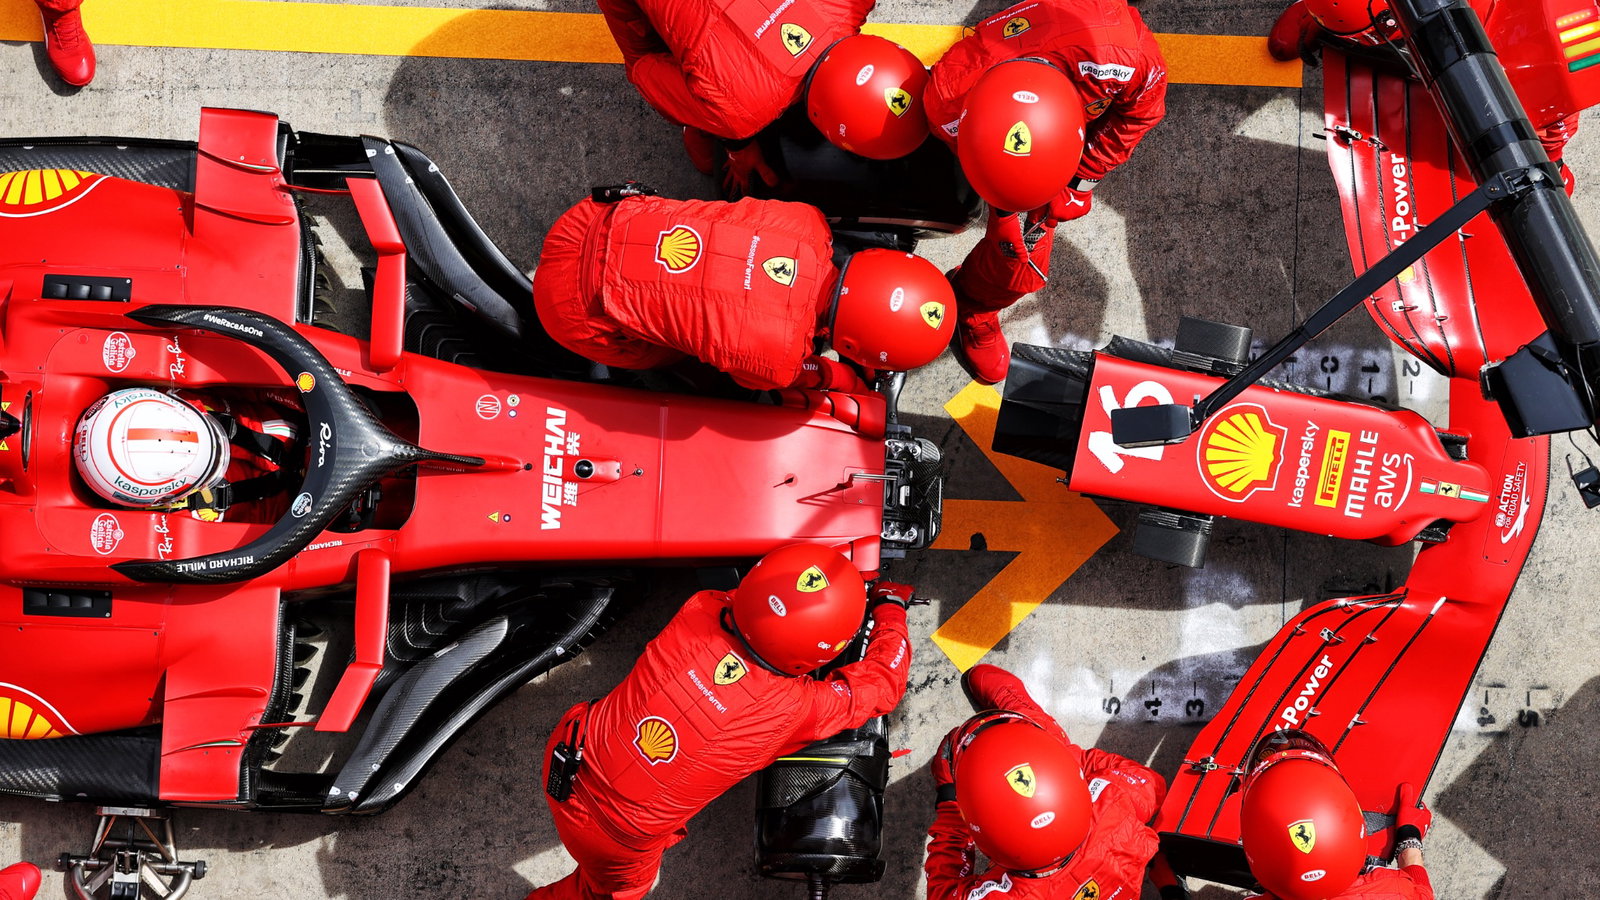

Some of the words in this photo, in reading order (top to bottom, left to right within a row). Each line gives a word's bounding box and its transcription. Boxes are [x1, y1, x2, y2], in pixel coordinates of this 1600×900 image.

[1081, 65, 1130, 80] kaspersky
[203, 314, 264, 338] #WeRaceAsOne
[1402, 359, 1421, 377] 2
[541, 406, 567, 530] WEICHAI
[1287, 420, 1320, 507] kaspersky
[1344, 430, 1379, 519] MAHLE
[1374, 453, 1401, 508] aws
[1512, 460, 1526, 493] SAFETY
[114, 475, 187, 496] kaspersky
[1498, 474, 1515, 513] ACTION
[1508, 493, 1519, 517] ROAD
[1504, 516, 1512, 528] FOR
[308, 540, 343, 551] RICHARD
[177, 561, 206, 573] MILLE
[210, 556, 254, 569] RICHARD
[1185, 698, 1205, 717] 3
[1034, 815, 1052, 826] BELL
[1304, 872, 1322, 880] BELL
